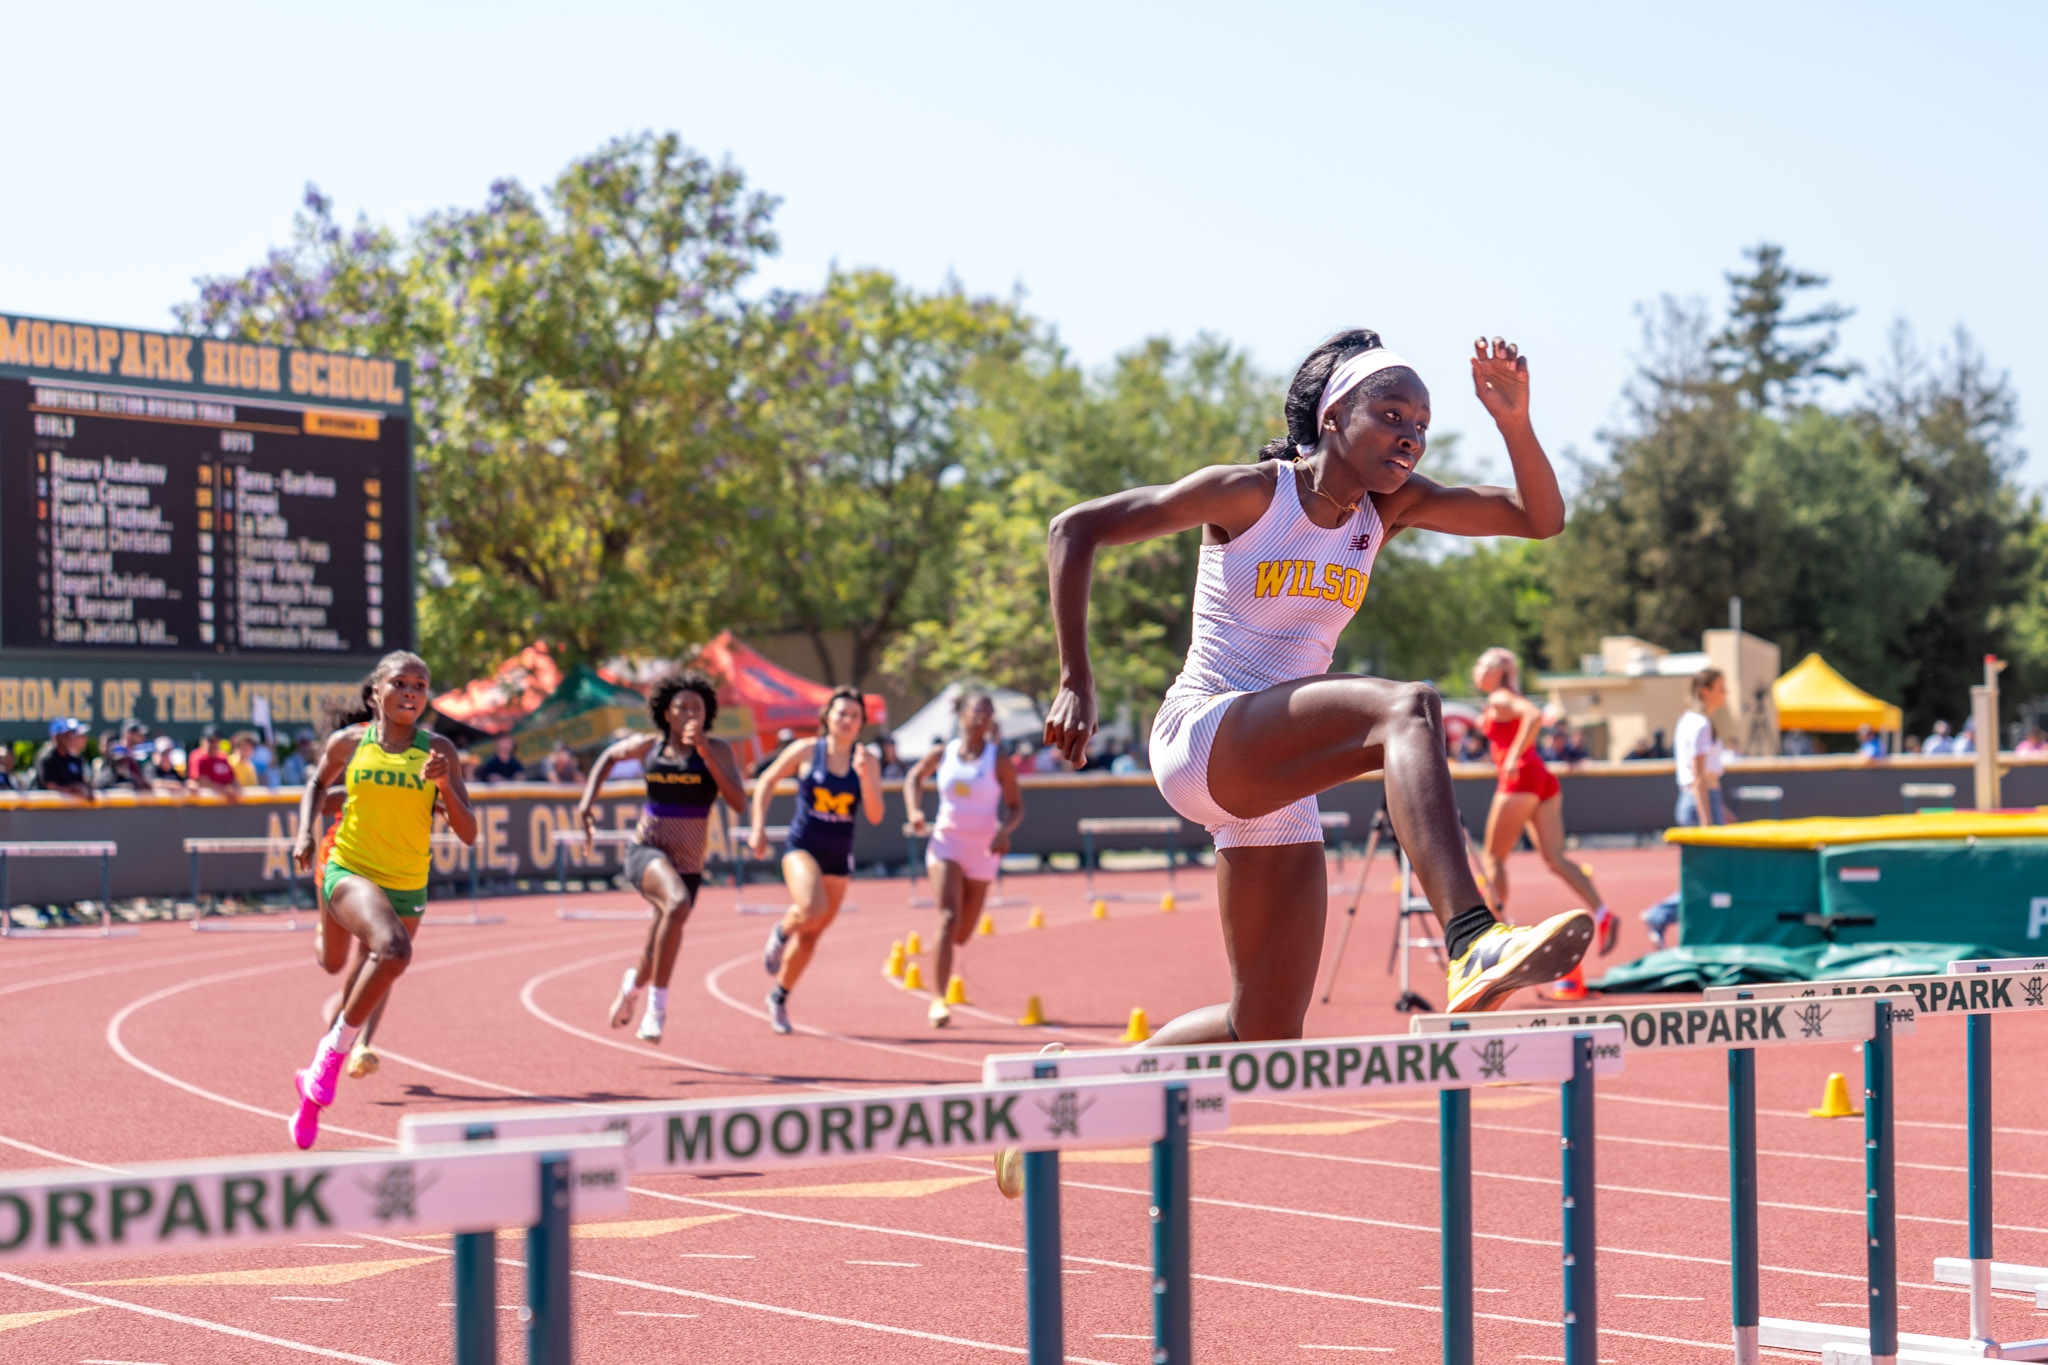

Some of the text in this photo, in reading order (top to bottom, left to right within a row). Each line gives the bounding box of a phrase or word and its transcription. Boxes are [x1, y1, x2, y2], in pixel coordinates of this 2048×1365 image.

[0, 316, 404, 405] MOORPARK HIGH SCHOOL
[34, 414, 75, 438] GIRLS
[220, 430, 254, 453] BOYS
[103, 455, 167, 485] Academy
[108, 527, 171, 554] Christian
[101, 572, 166, 598] Christian
[0, 677, 93, 722] HOME
[103, 679, 142, 722] OF
[152, 680, 214, 722] THE
[354, 769, 427, 791] POLY
[813, 786, 855, 816] M
[666, 1094, 1023, 1165] MOORPARK
